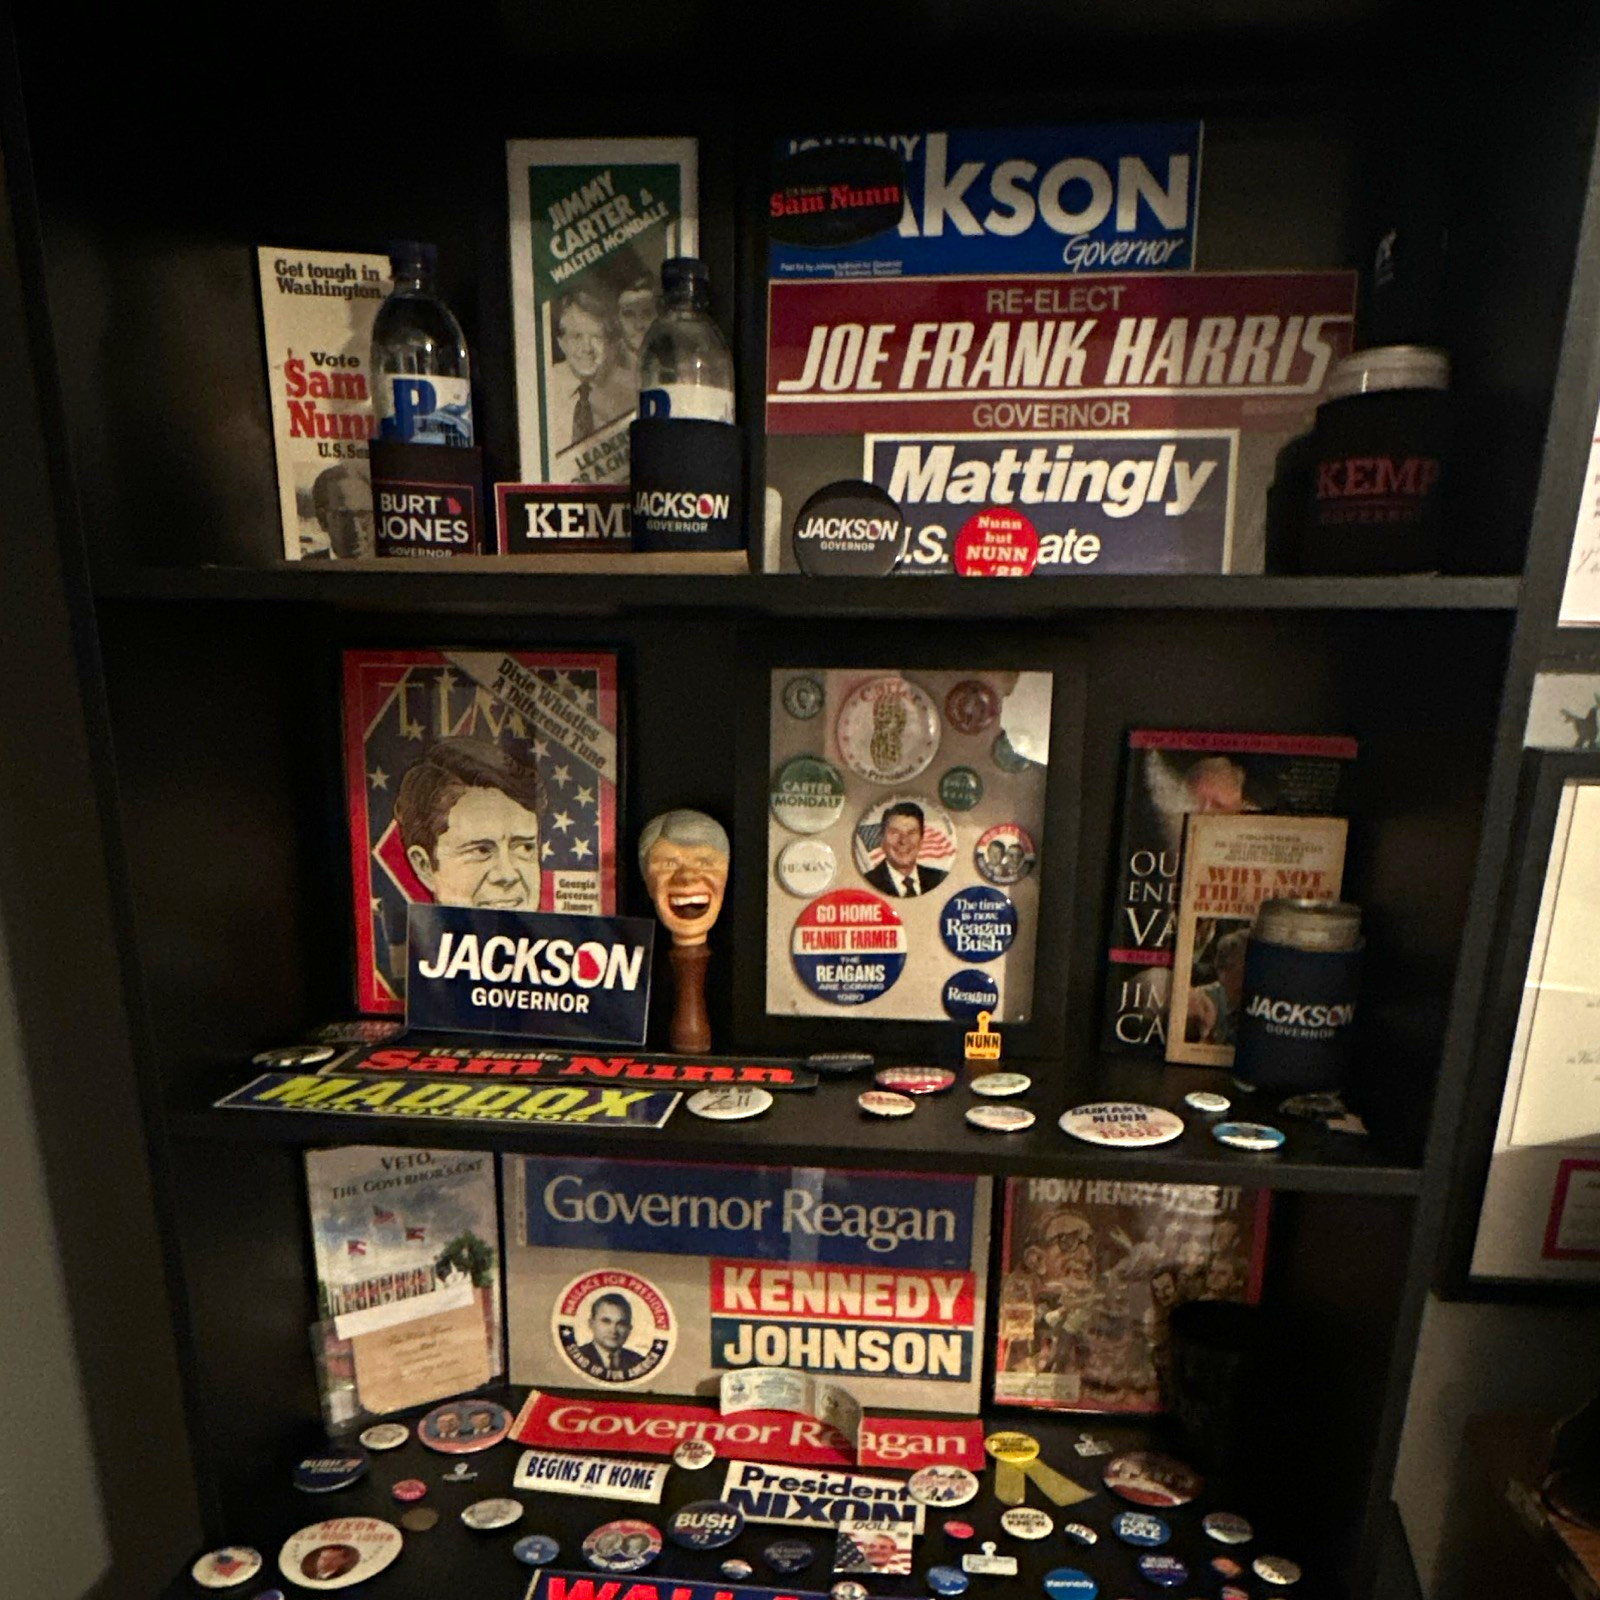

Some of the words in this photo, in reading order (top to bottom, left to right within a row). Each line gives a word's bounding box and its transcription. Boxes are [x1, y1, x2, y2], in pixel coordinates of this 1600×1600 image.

[898, 132, 1190, 237] kSON
[548, 170, 615, 231] JIMMY
[770, 192, 826, 218] Sam
[829, 184, 900, 209] Nunn
[550, 193, 636, 260] CARTER
[551, 244, 603, 284] WALTER
[602, 201, 669, 252] MONDALE
[1062, 234, 1184, 272] Governor
[274, 259, 304, 278] Get
[307, 262, 357, 282] tough
[361, 264, 380, 281] in
[986, 285, 1127, 314] RE-ELECT
[310, 352, 360, 368] Vote
[777, 323, 896, 392] JOE
[898, 319, 1098, 389] FRANK
[1103, 314, 1354, 393] HARRIS
[284, 357, 368, 400] Sam
[972, 402, 1131, 428] GOVERNOR
[888, 443, 1217, 518] Mattingly
[380, 492, 441, 515] BURT
[634, 491, 730, 520] JACKSON
[378, 518, 469, 544] JONES
[524, 502, 631, 539] KEM
[646, 520, 708, 533] GOVERNOR
[798, 517, 899, 542] JACKSON
[978, 516, 1023, 531] Nunn
[820, 540, 875, 551] GOVERNOR
[985, 529, 1012, 545] but
[1036, 527, 1101, 565] ate
[966, 546, 1028, 561] NUNN
[498, 658, 536, 693] Dixie
[540, 685, 600, 741] Whistles
[509, 685, 569, 741] Different
[569, 732, 607, 769] Tune
[782, 781, 832, 795] CARTER
[775, 795, 844, 808] MONDALE
[1130, 850, 1179, 877] OU
[559, 878, 596, 890] Georgia
[1208, 867, 1263, 885] WHY
[1276, 869, 1326, 887] NOT
[562, 902, 593, 913] Jimmy
[816, 905, 836, 922] GO
[840, 904, 883, 922] HOME
[955, 899, 977, 911] The
[979, 898, 1006, 911] time
[802, 930, 847, 950] PEANUT
[850, 930, 897, 949] FARMER
[946, 918, 1012, 937] Reagan
[957, 935, 1003, 952] Bush
[418, 933, 645, 991] JACKSON
[816, 964, 885, 982] REAGANS
[471, 987, 589, 1013] GOVERNOR
[948, 987, 997, 1003] Reagan
[1247, 995, 1355, 1027] JACKSON
[966, 1034, 1000, 1047] NUNN
[357, 1049, 542, 1075] Sam
[559, 1055, 795, 1084] Nunn
[254, 1075, 653, 1117] MADDOX
[1071, 1105, 1154, 1116] DUKAKIS
[1093, 1113, 1148, 1123] NUNN
[332, 1184, 360, 1201] THE
[1028, 1177, 1083, 1204] HOW
[543, 1175, 772, 1231] Governor
[782, 1188, 956, 1253] Reagan
[603, 1275, 626, 1285] FOR
[628, 1278, 669, 1331] PRESIDENT
[723, 1267, 964, 1320] KENNEDY
[723, 1324, 962, 1376] JOHNSON
[548, 1405, 781, 1442] Governor
[526, 1456, 580, 1485] BEGINS
[585, 1462, 607, 1485] AT
[607, 1464, 656, 1490] HOME
[740, 1465, 911, 1501] President
[727, 1487, 917, 1523] NIXON
[321, 1520, 379, 1532] NIXON
[674, 1511, 738, 1530] BUSH
